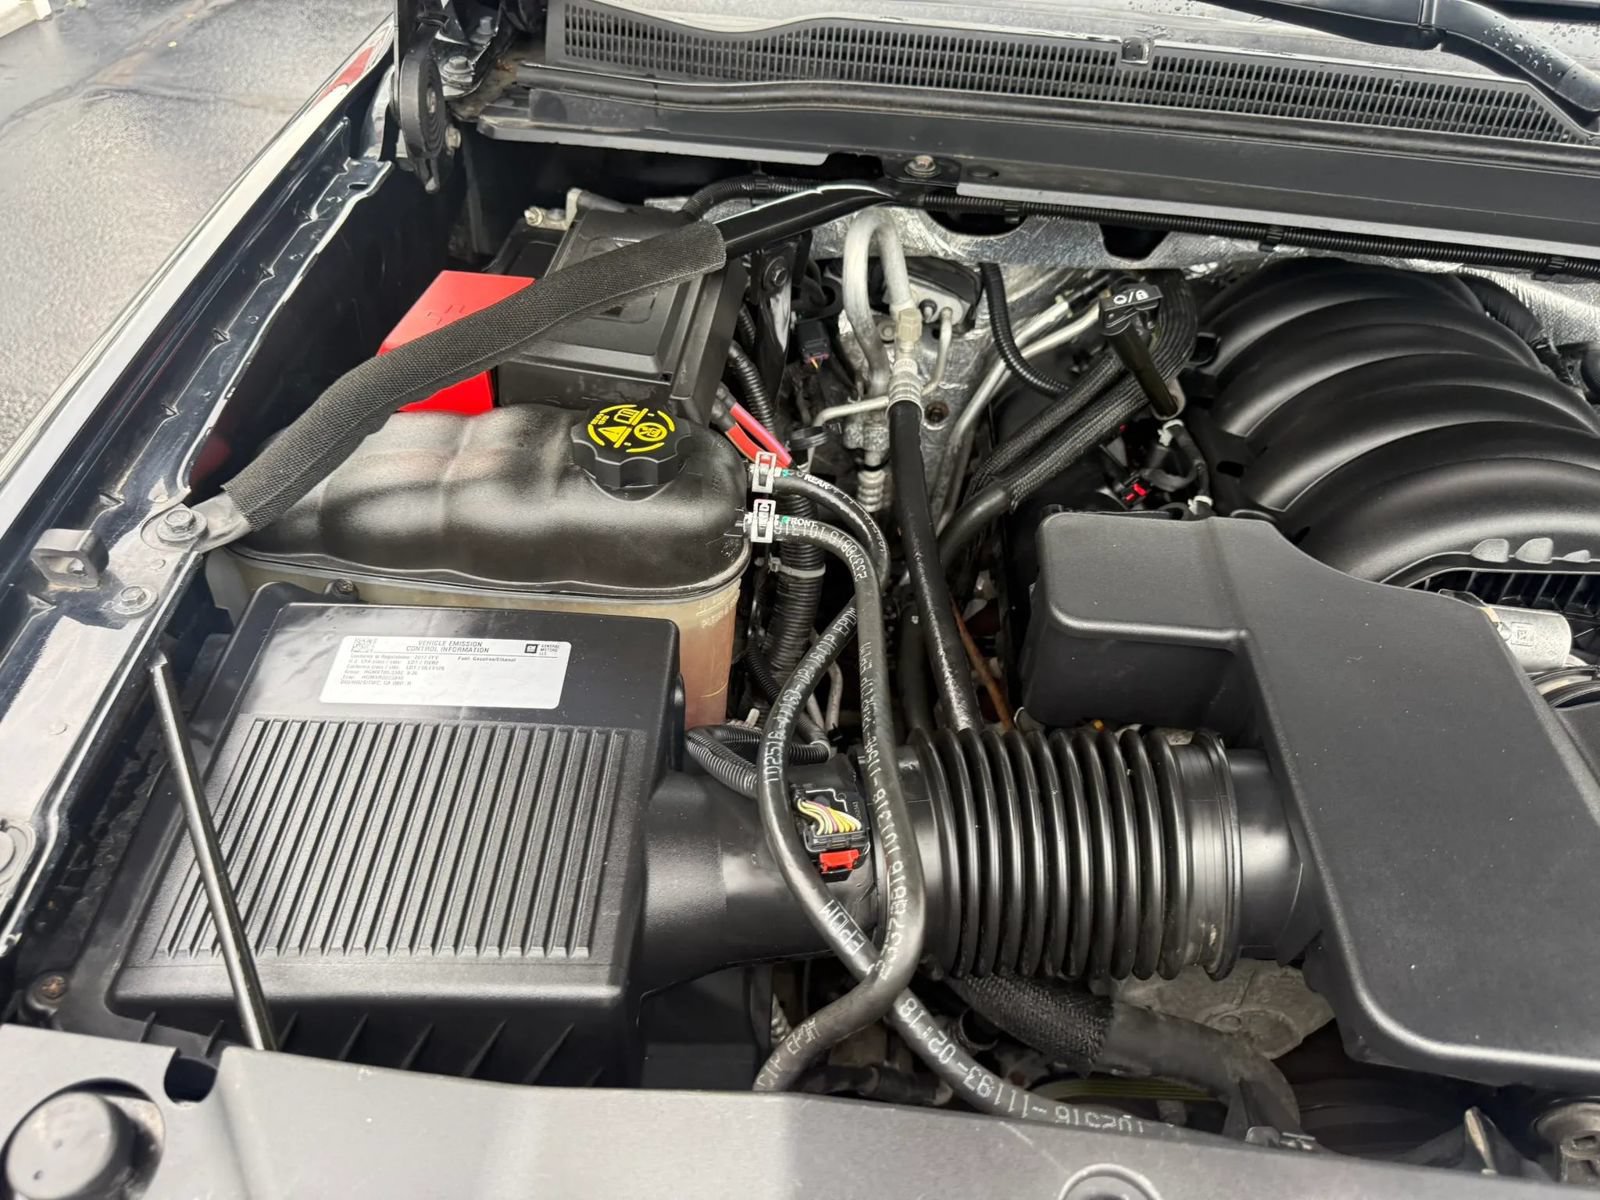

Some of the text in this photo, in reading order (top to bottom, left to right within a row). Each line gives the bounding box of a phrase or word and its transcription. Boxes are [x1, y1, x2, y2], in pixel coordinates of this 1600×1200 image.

[804, 473, 830, 490] REAR
[783, 516, 819, 527] RONT
[819, 899, 867, 956] EPDM
